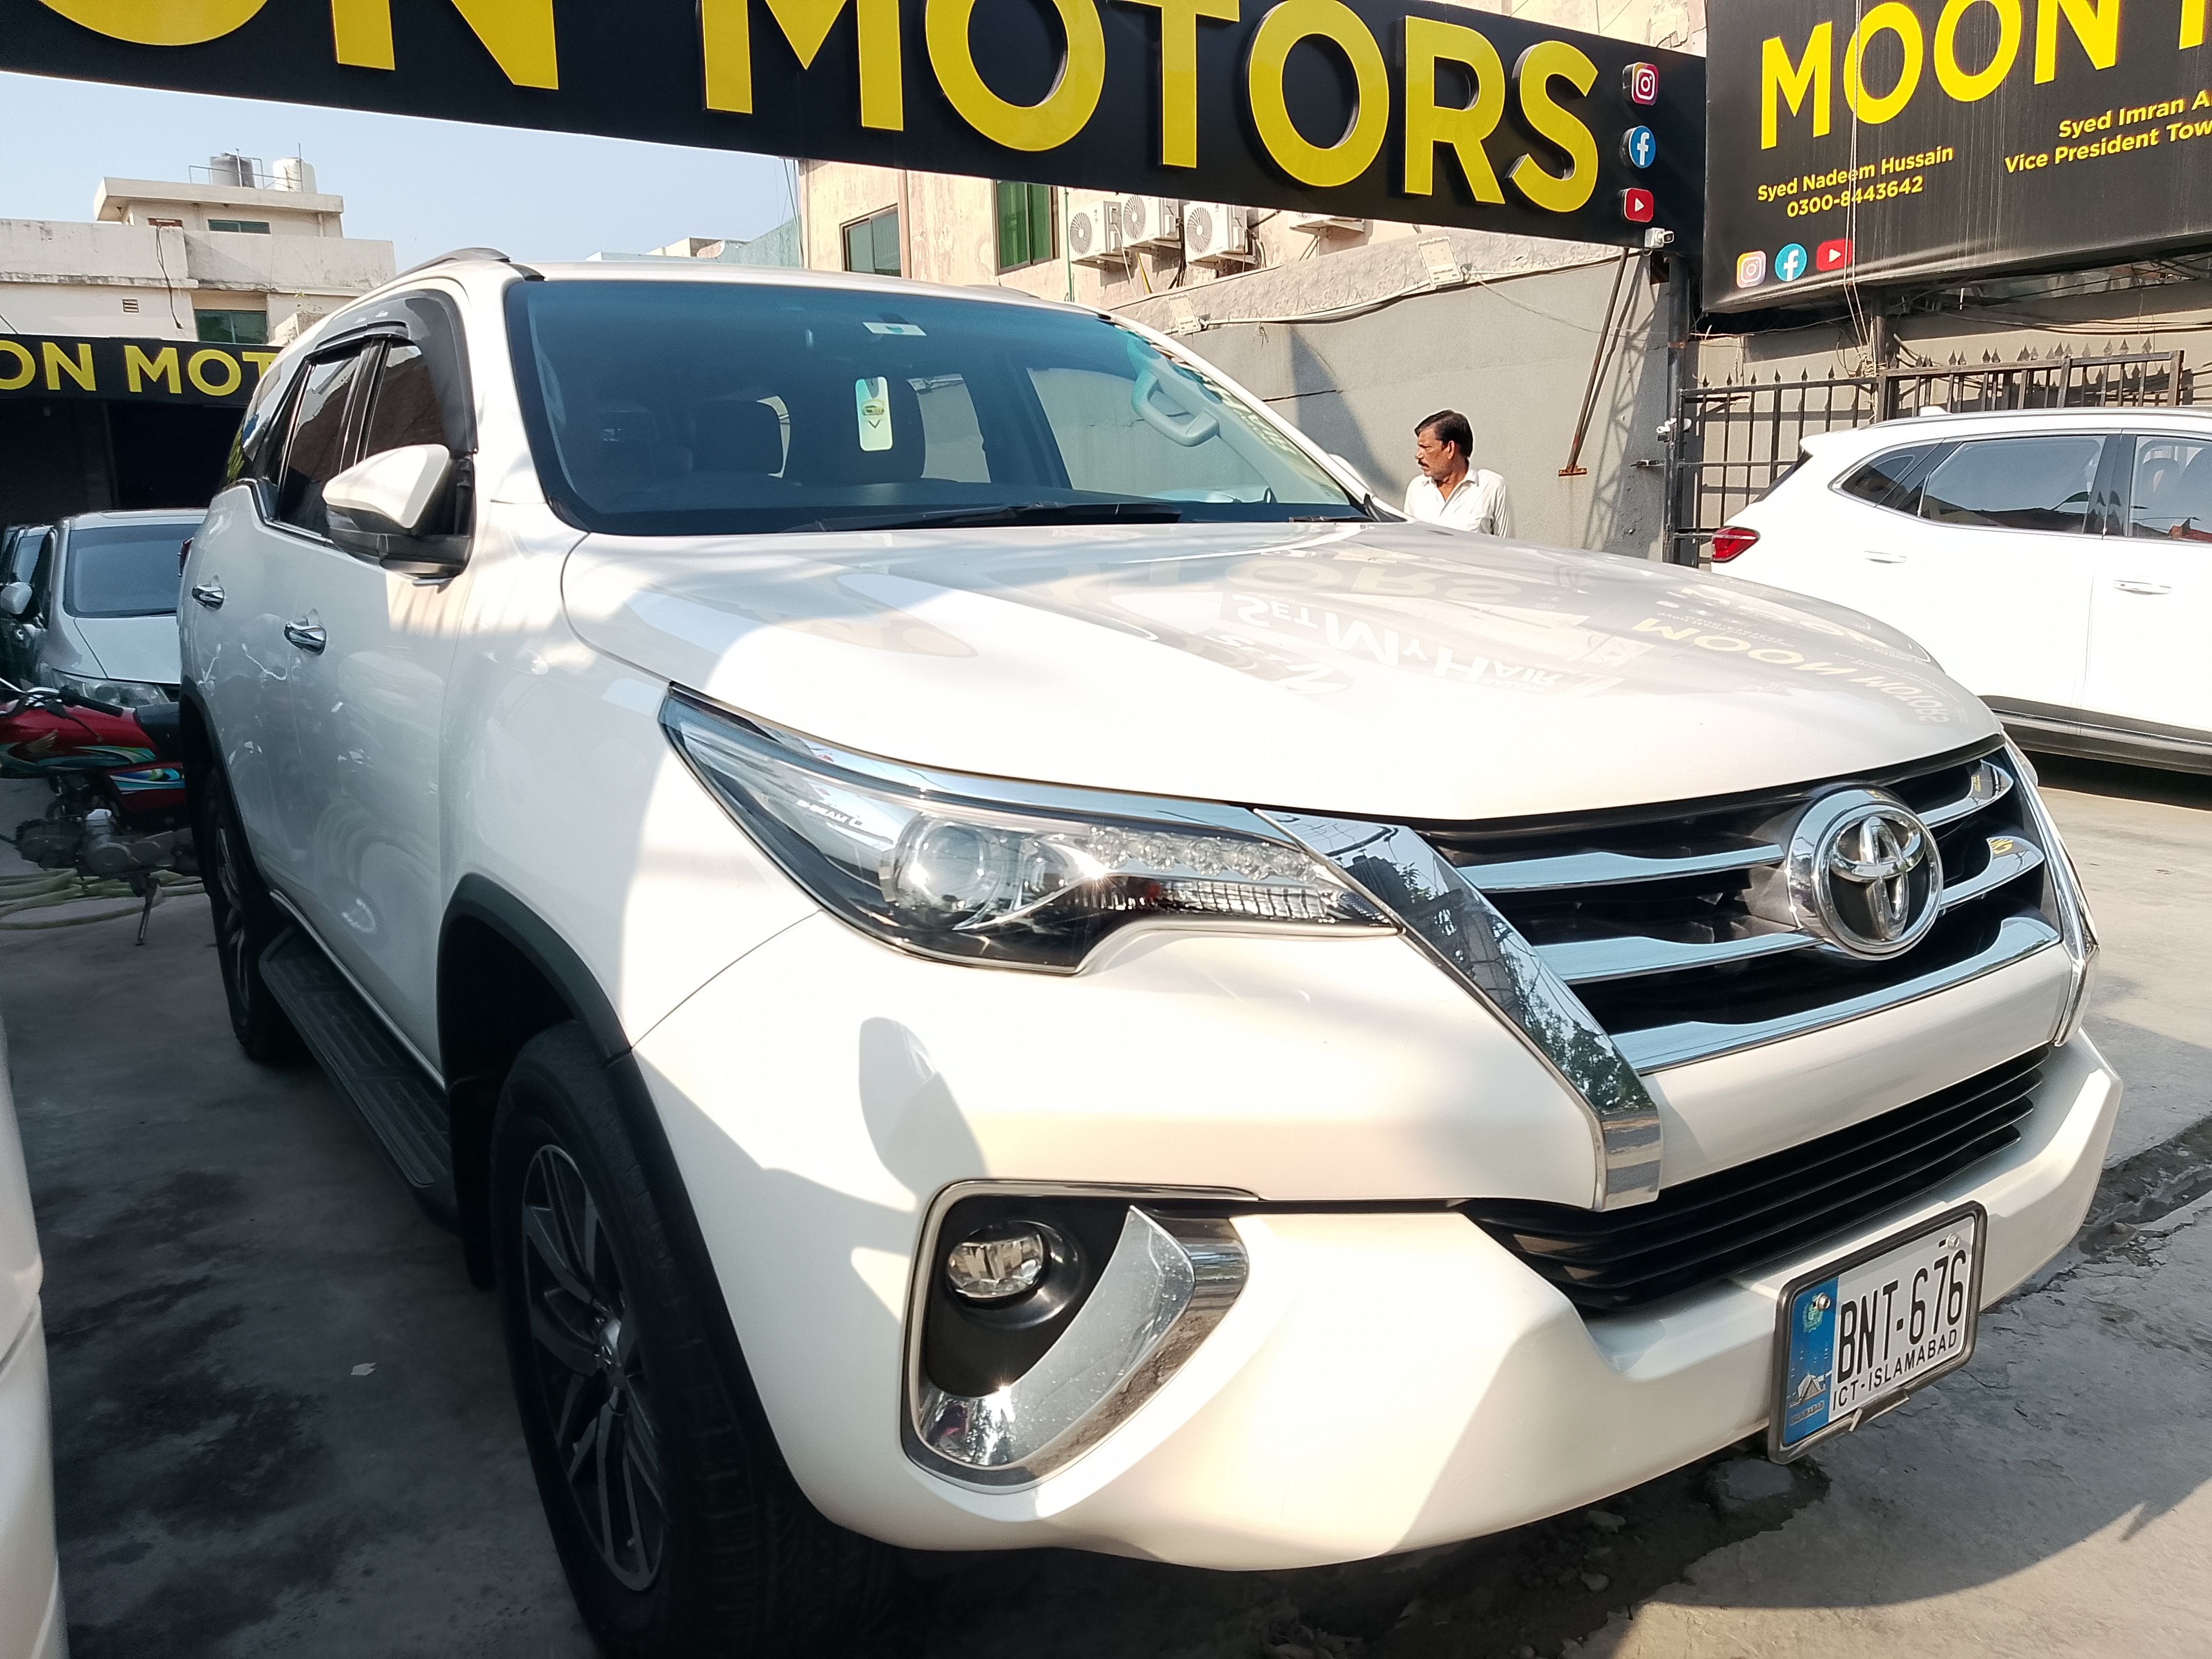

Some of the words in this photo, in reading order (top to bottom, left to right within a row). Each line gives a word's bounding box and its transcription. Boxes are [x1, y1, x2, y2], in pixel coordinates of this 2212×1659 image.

[1761, 0, 2120, 150] MOON
[701, 0, 1599, 213] MOTORS
[2058, 110, 2112, 139] Syed
[2118, 98, 2184, 126] Imran
[2191, 89, 2212, 110] A
[1757, 177, 1798, 202] Syed
[1803, 165, 1875, 191] Nadeem
[1881, 146, 1954, 175] Hussain
[2005, 154, 2048, 173] Vice
[2055, 128, 2159, 164] President
[1787, 175, 1923, 218] 0300-8443642
[0, 339, 97, 391] ON
[1837, 1249, 1967, 1384] BNT-676
[1832, 1328, 1957, 1411] ICT-ISLAMABAD
